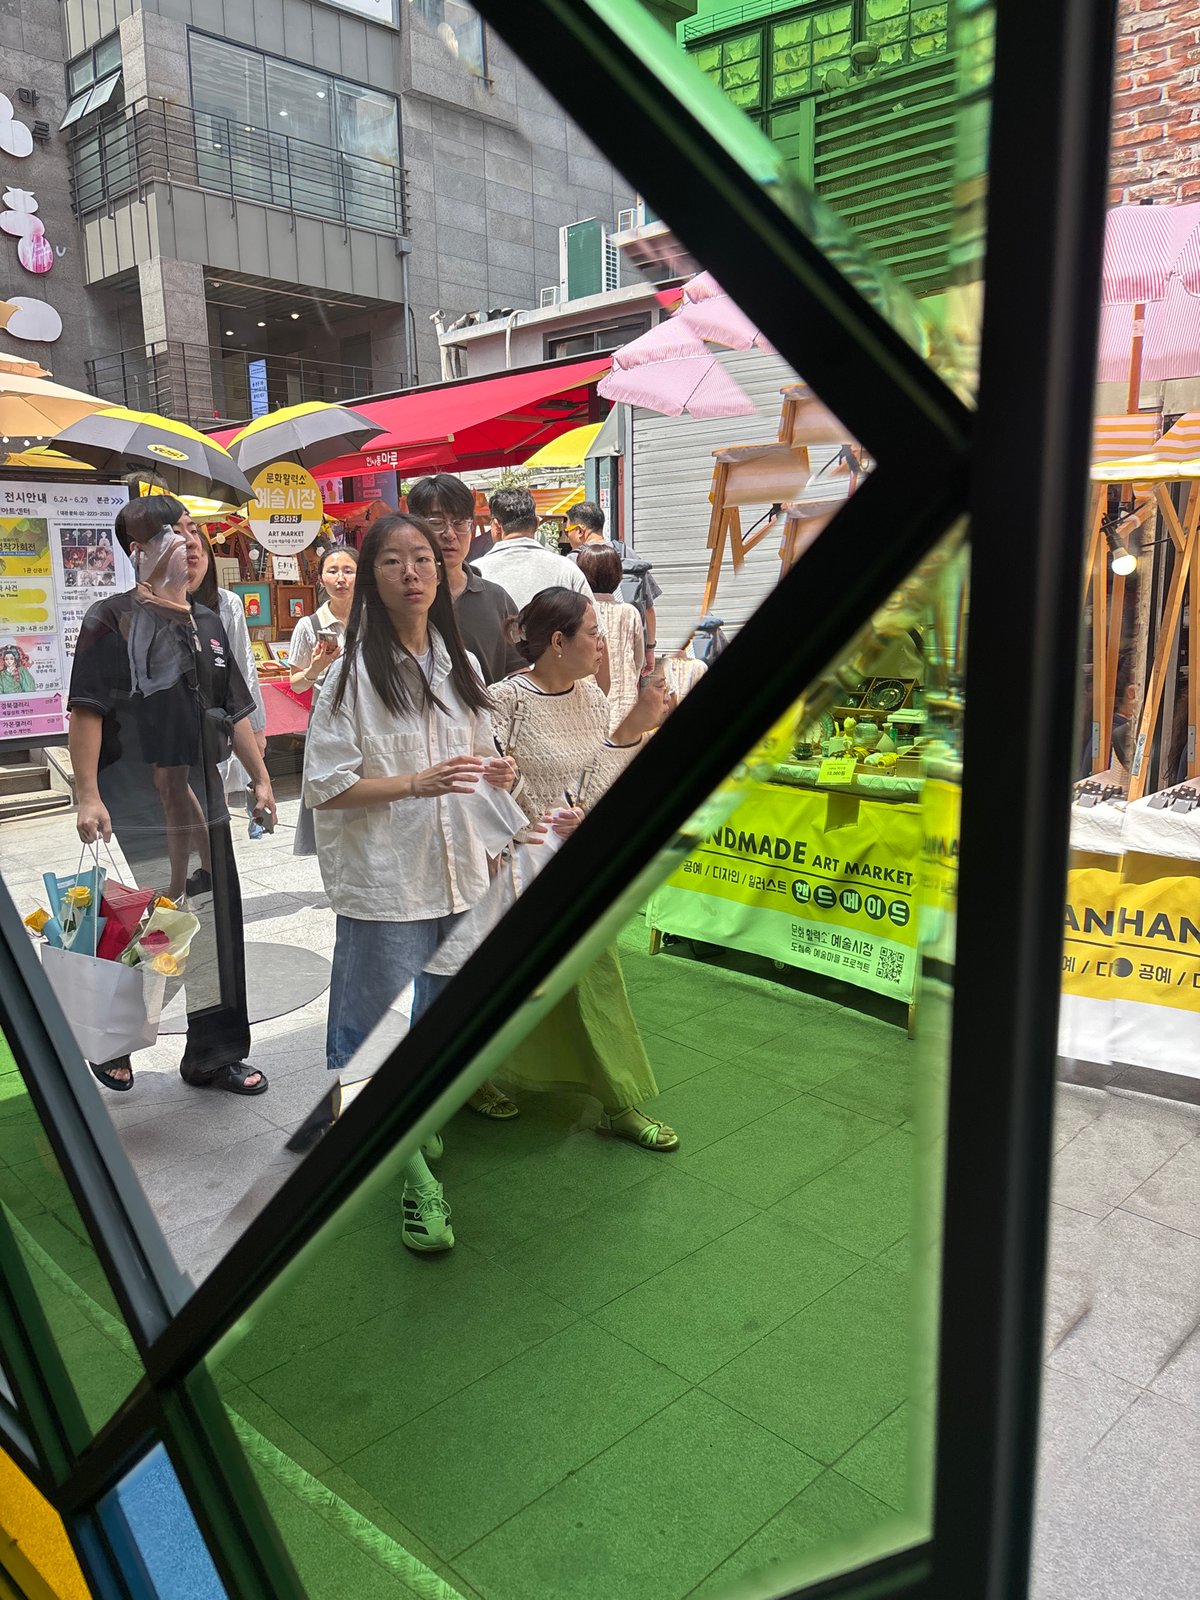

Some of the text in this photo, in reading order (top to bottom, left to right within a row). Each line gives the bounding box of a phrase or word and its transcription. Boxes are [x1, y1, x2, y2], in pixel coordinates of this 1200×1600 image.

[366, 451, 399, 470] 인사동 마루
[266, 473, 307, 486] 문화활력소
[4, 492, 48, 504] 전시안내
[96, 496, 110, 504] 본관
[254, 487, 317, 510] 예술시장
[812, 854, 840, 872] ART
[844, 861, 913, 886] MARKET
[683, 860, 703, 875] 공예
[712, 865, 740, 884] 디자인
[748, 874, 787, 895] 일러스트
[792, 880, 910, 926] 핸드메이드
[831, 933, 874, 957] 예술시장
[790, 942, 871, 974] 도심속 예술마을 프로젝트
[1138, 963, 1172, 984] 공예
